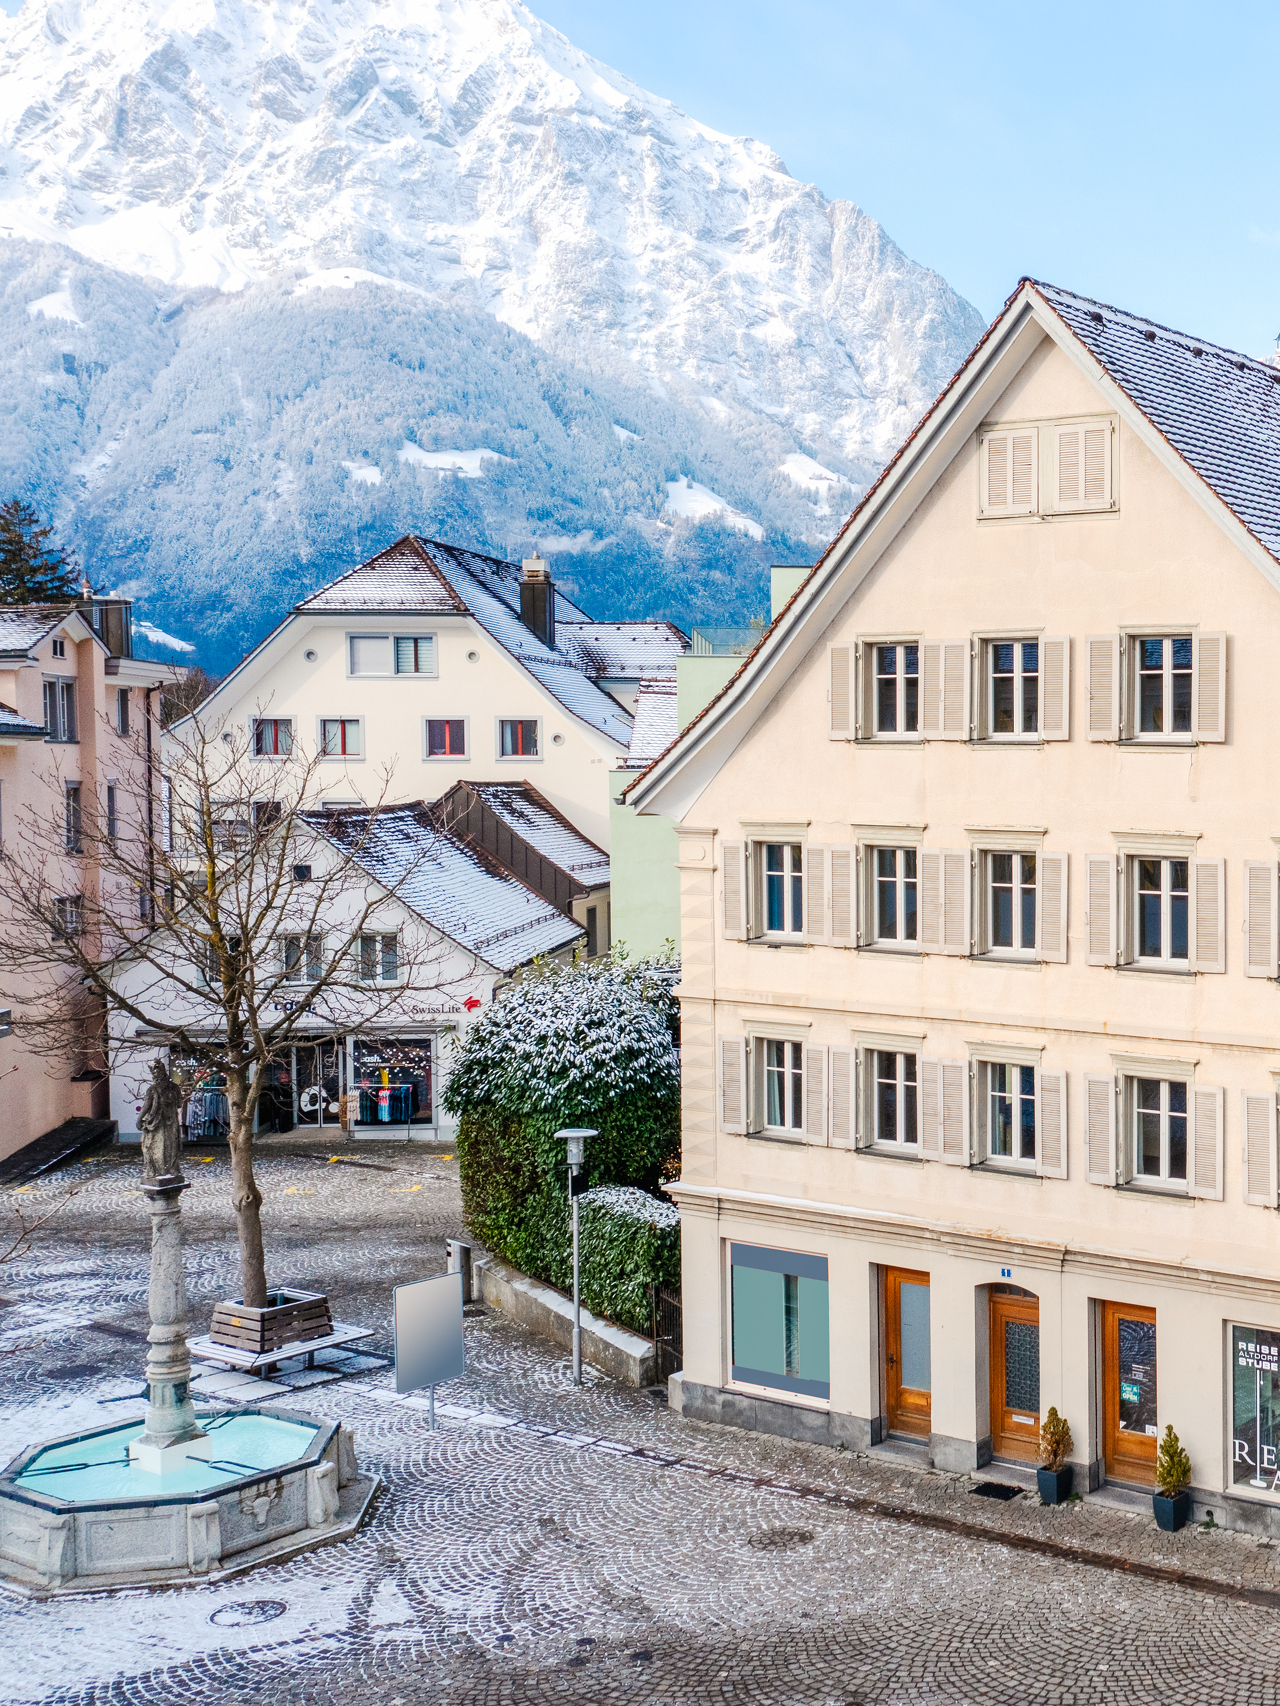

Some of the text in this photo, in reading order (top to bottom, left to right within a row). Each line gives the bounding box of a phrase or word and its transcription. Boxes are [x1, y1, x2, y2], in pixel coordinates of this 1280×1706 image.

[1238, 1341, 1279, 1356] REISE
[1238, 1350, 1279, 1362] ALTDORF
[1238, 1357, 1279, 1372] STUBE
